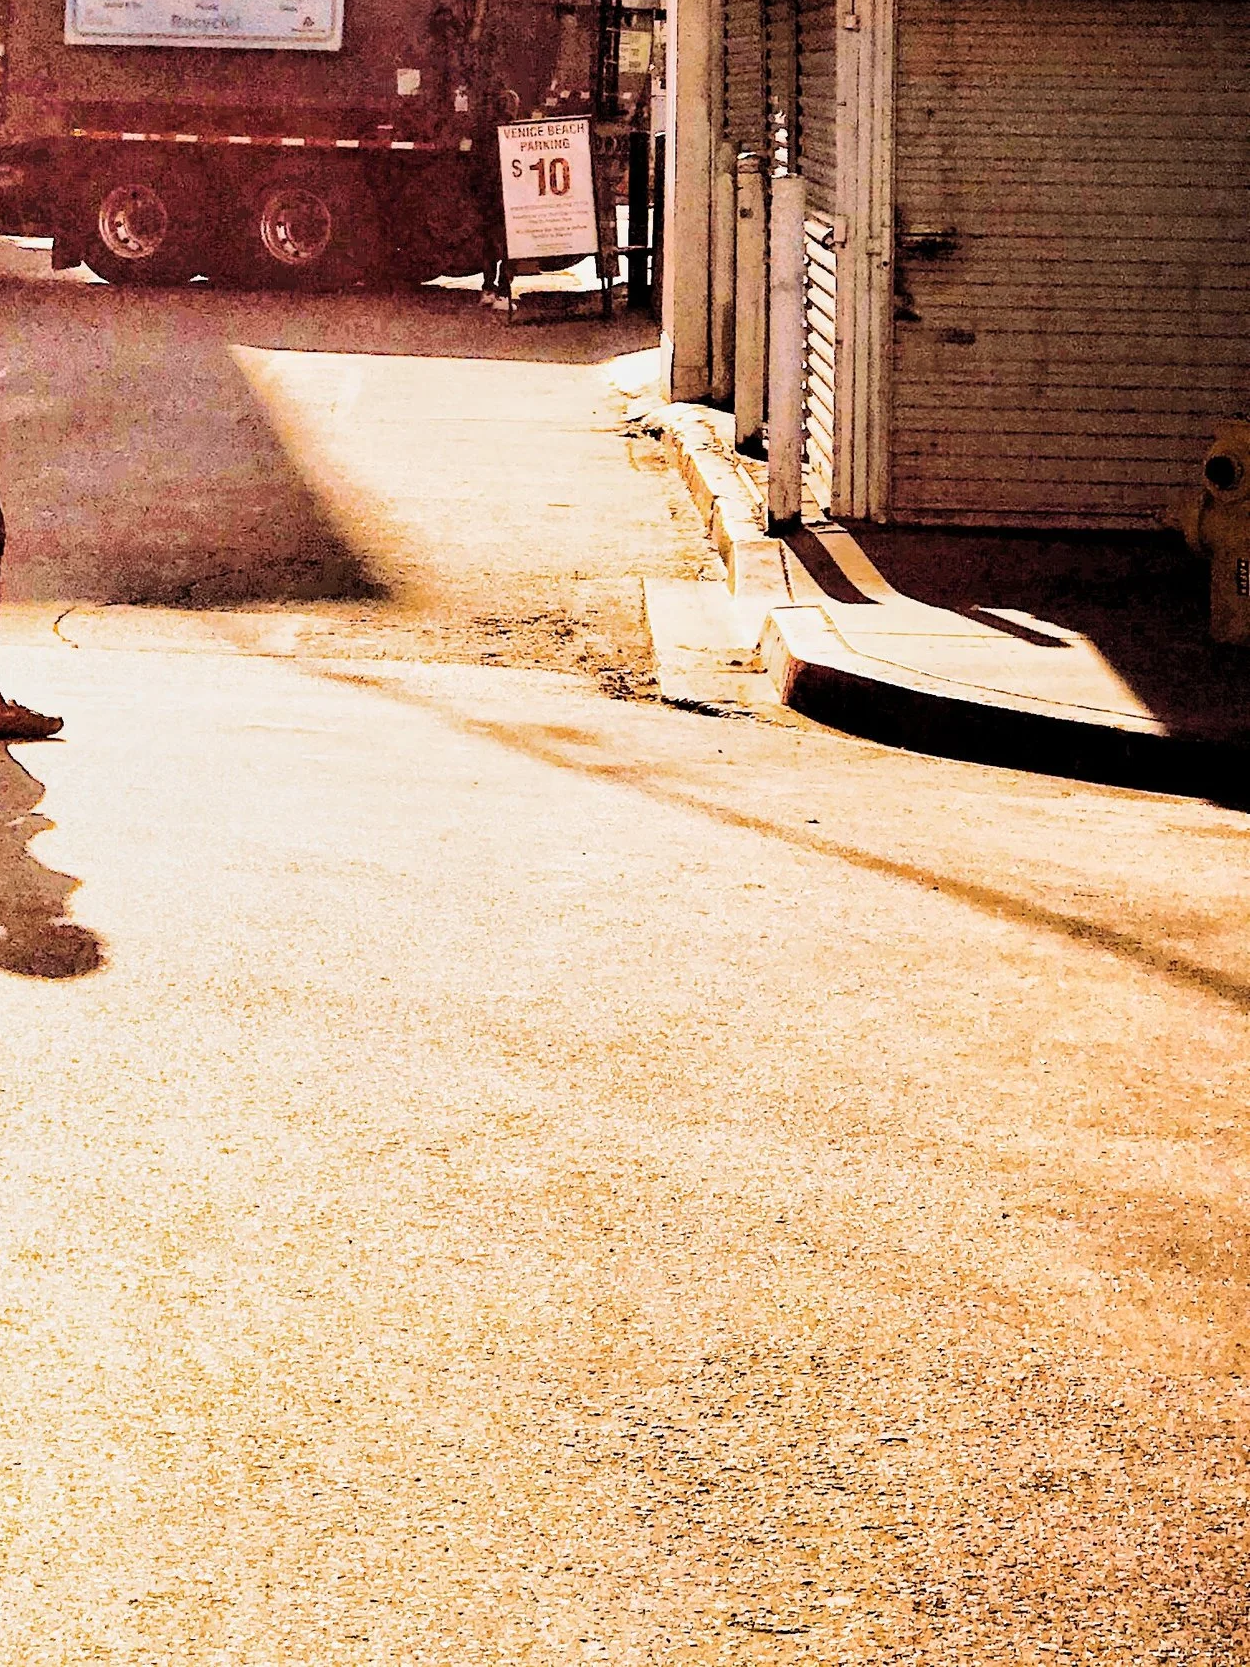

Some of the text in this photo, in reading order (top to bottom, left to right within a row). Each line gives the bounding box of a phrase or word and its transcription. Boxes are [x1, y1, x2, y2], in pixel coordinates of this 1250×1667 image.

[503, 122, 586, 139] VENICE BEACH
[520, 138, 571, 152] PARKING
[511, 157, 571, 196] $ 10
